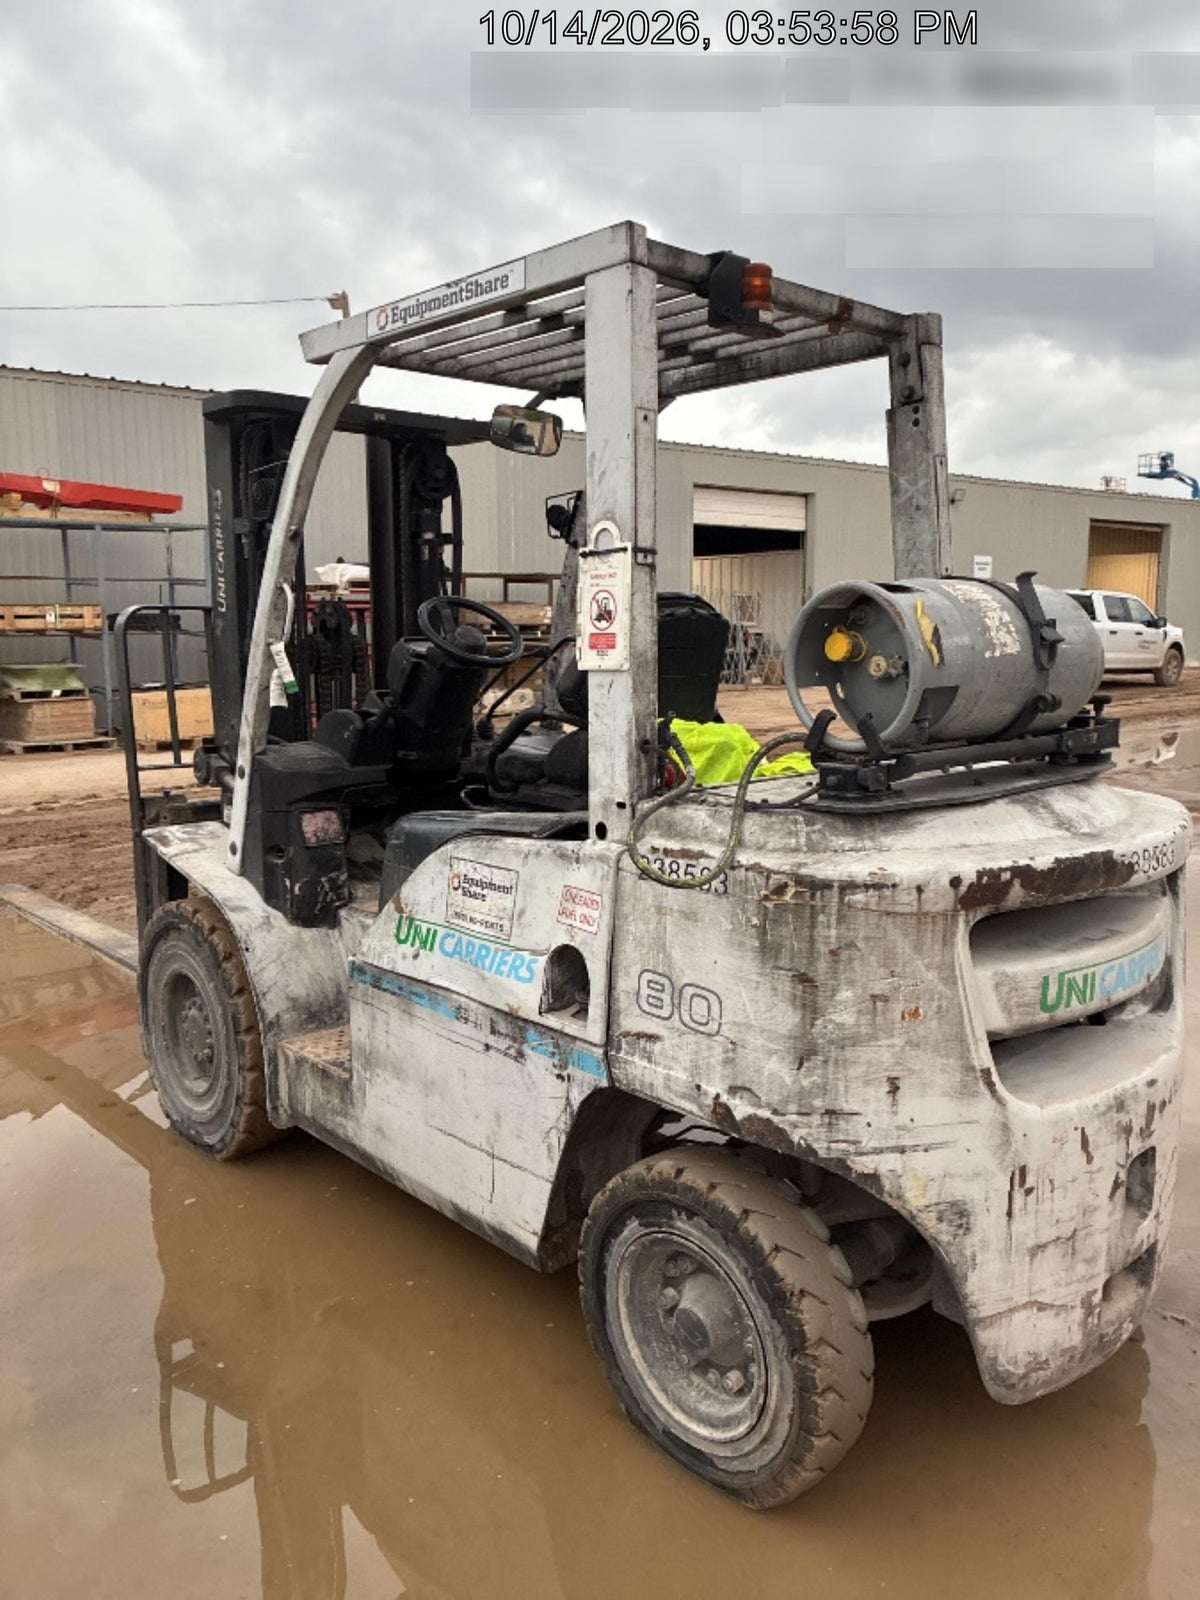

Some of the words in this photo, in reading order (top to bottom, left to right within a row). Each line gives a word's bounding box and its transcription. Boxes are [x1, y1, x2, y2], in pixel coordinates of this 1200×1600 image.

[391, 273, 510, 325] EquipmentShare
[461, 887, 487, 902] Share
[462, 874, 514, 896] Equipment
[636, 968, 723, 1037] 80
